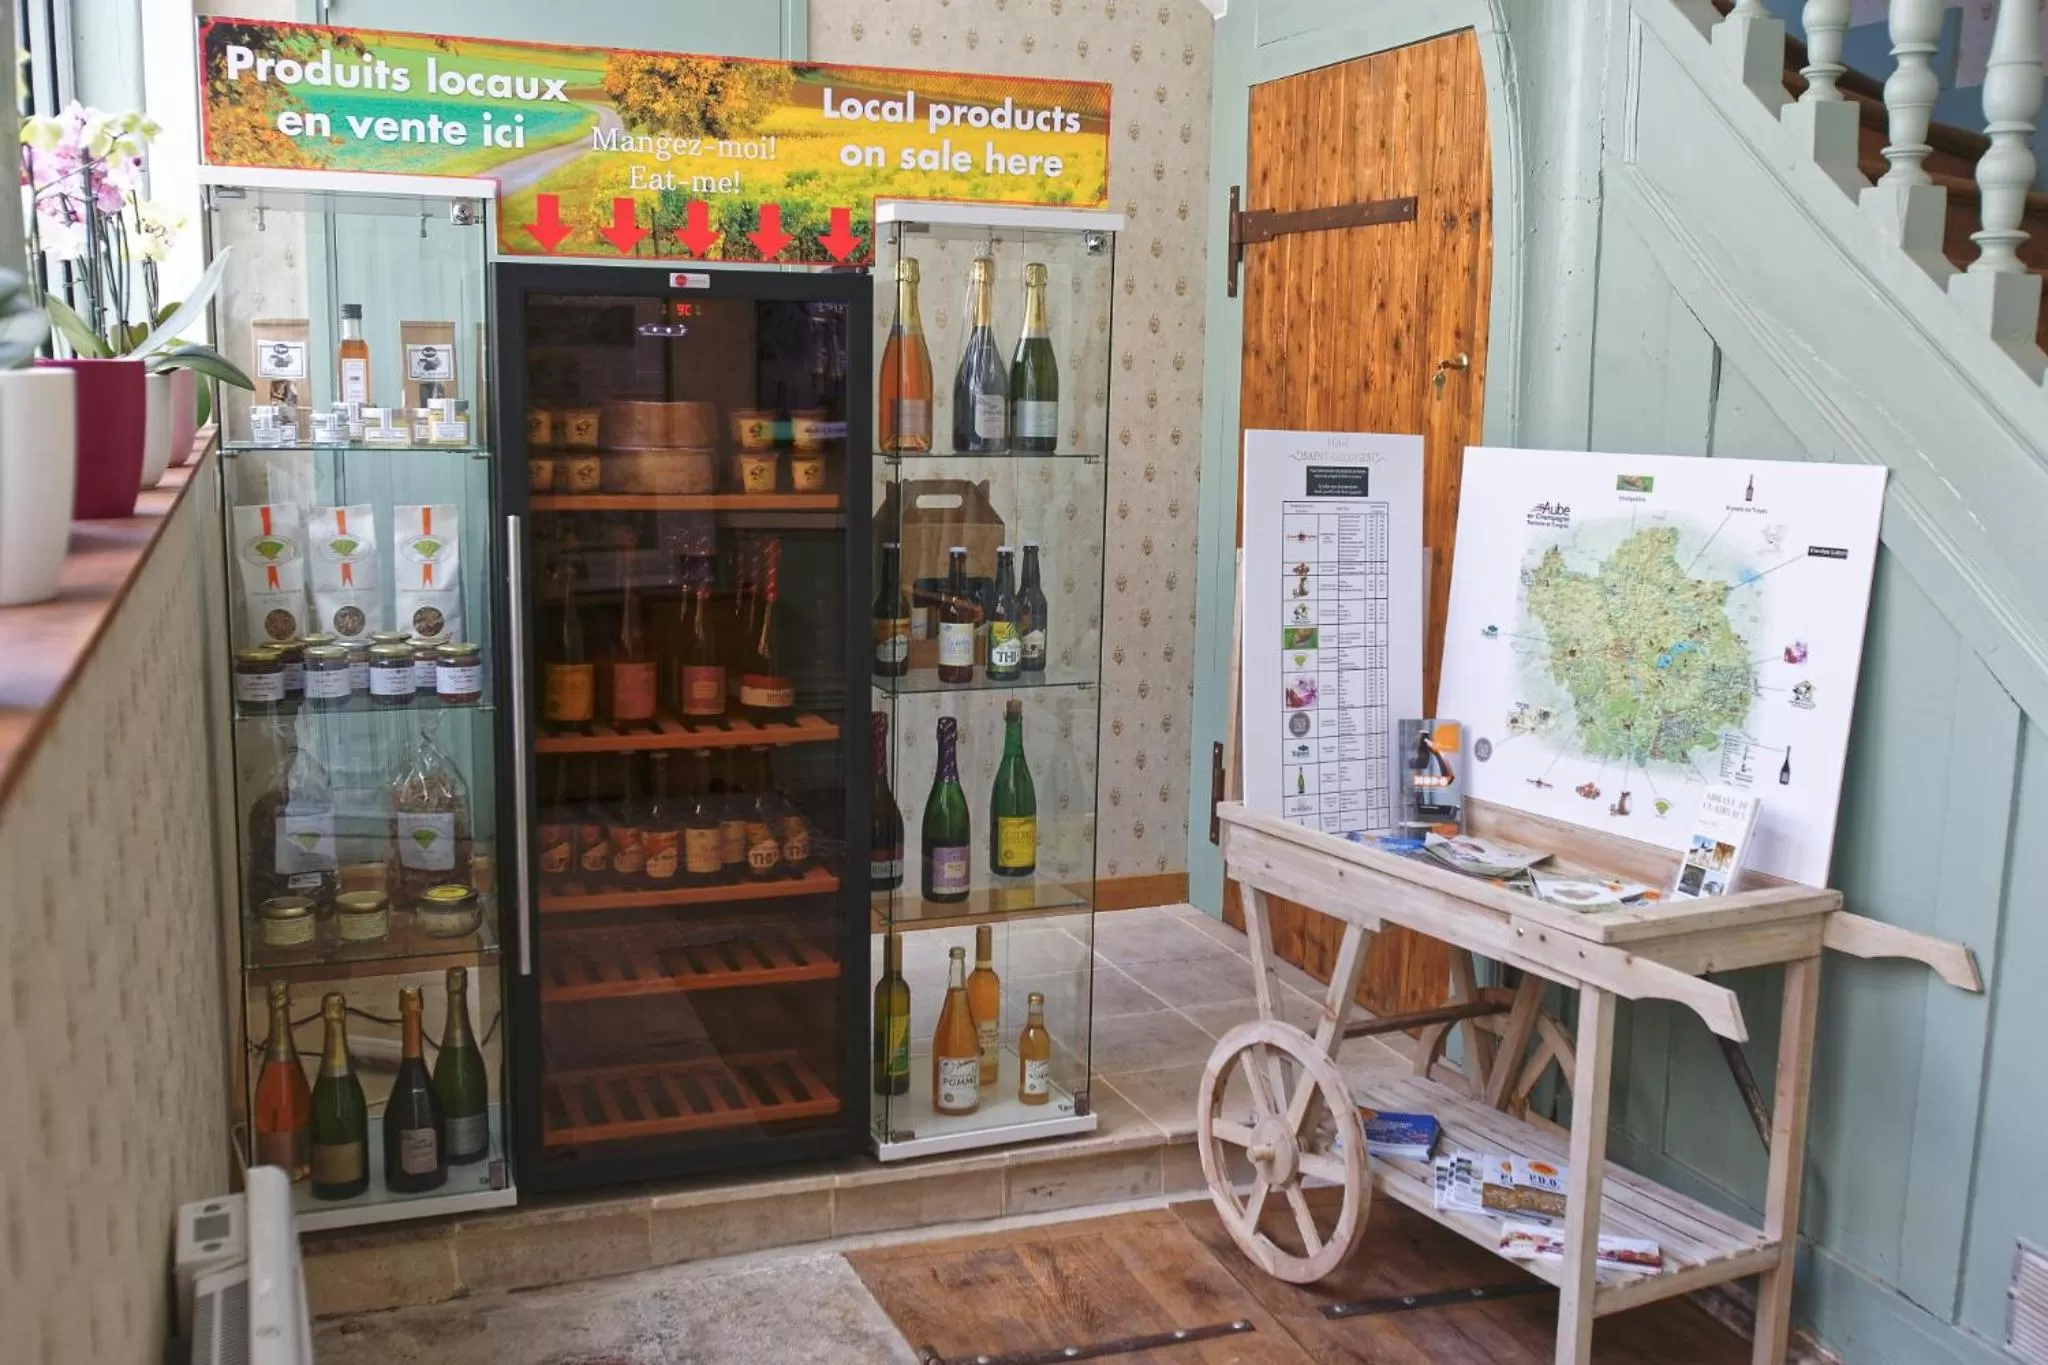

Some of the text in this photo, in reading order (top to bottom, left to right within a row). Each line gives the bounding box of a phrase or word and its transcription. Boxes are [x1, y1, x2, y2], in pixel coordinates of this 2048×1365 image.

[226, 45, 569, 102] Produits locaux
[823, 88, 1081, 133] Local products
[277, 110, 526, 149] en vente ici
[591, 126, 777, 162] Mangez-moi!
[840, 142, 1063, 177] on sale here
[629, 166, 741, 195] Eat-me!
[1540, 501, 1571, 515] Aube
